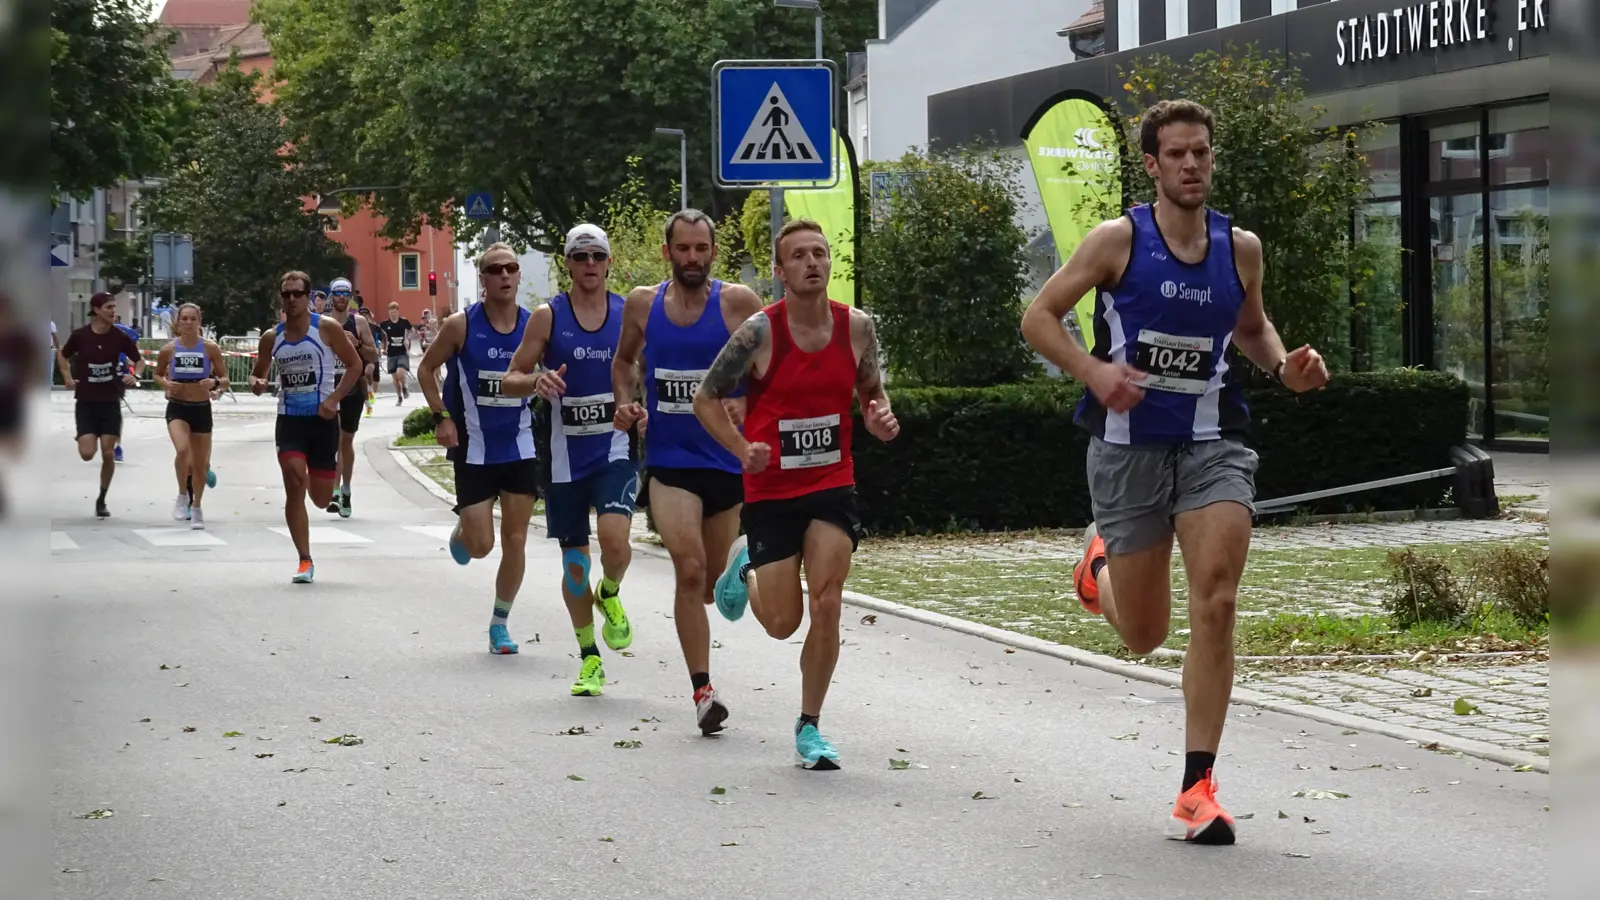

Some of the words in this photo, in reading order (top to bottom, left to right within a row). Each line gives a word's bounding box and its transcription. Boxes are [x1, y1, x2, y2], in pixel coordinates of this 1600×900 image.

[1336, 0, 1486, 66] STADTWERKE
[1179, 282, 1212, 306] Sempt
[180, 357, 199, 366] 1091
[278, 353, 313, 365] ERDINGER
[586, 346, 612, 362] Sempt
[1149, 346, 1201, 372] 1042
[286, 373, 310, 384] 1007
[1161, 369, 1181, 377] Anton
[665, 381, 701, 398] 1118
[571, 404, 606, 421] 1051
[792, 428, 832, 449] 1018
